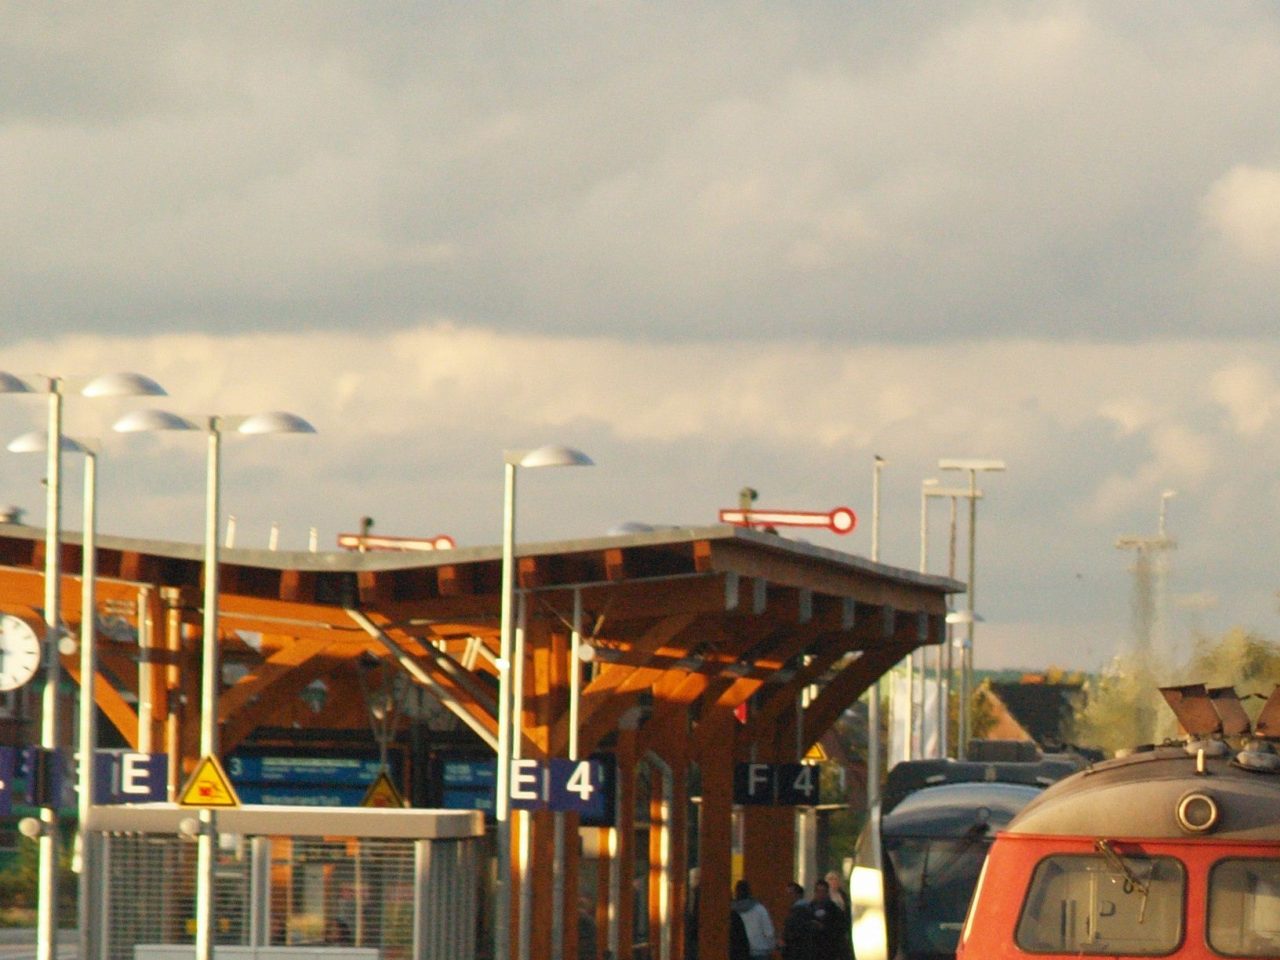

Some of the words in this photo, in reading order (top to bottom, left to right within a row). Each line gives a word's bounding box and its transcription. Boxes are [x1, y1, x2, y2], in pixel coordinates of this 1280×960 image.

[122, 753, 151, 794] E
[510, 759, 538, 799] E
[566, 760, 594, 800] 4
[748, 763, 769, 796] F
[793, 767, 815, 796] 4
